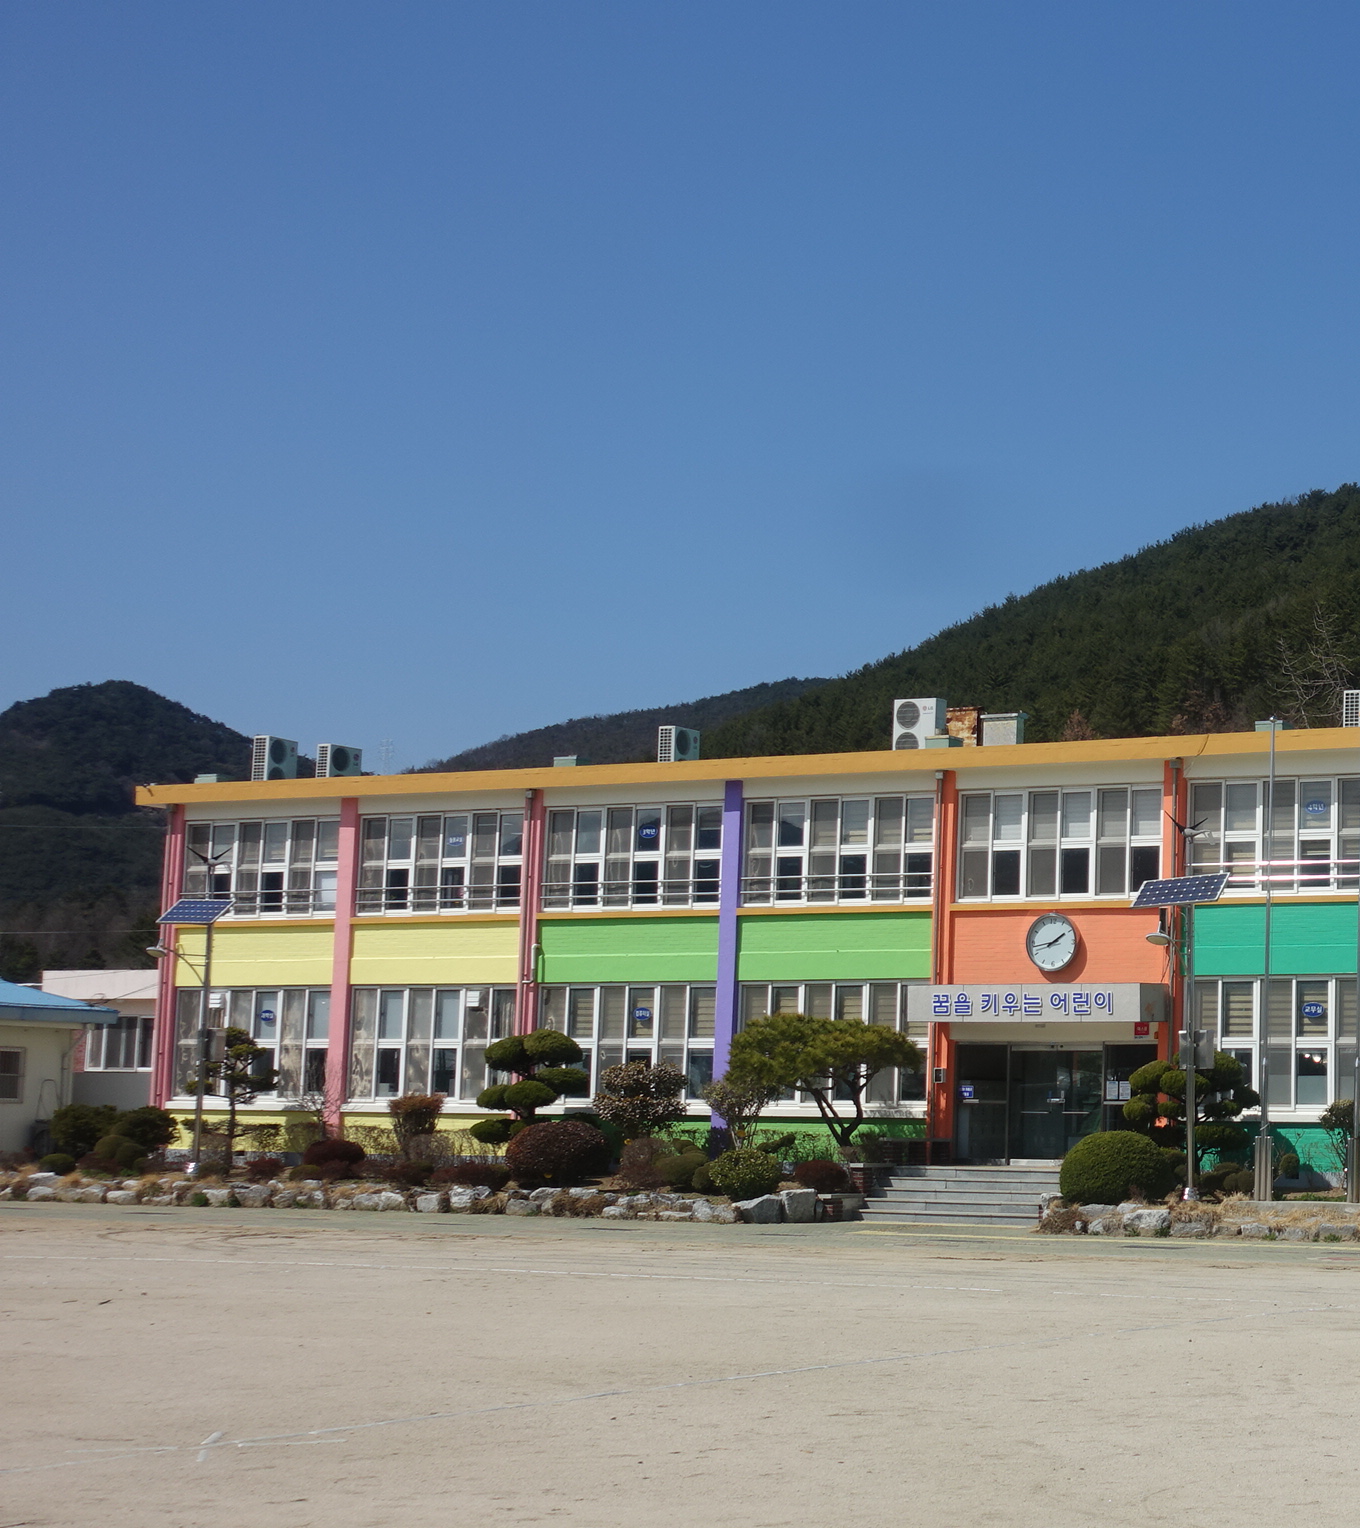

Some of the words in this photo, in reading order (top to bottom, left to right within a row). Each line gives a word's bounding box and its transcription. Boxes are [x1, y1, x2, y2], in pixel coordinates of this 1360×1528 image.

[932, 991, 972, 1015] 꿈을
[980, 992, 1043, 1016] 키우는
[1049, 991, 1113, 1016] 어린이
[1304, 1005, 1323, 1014] 교무실
